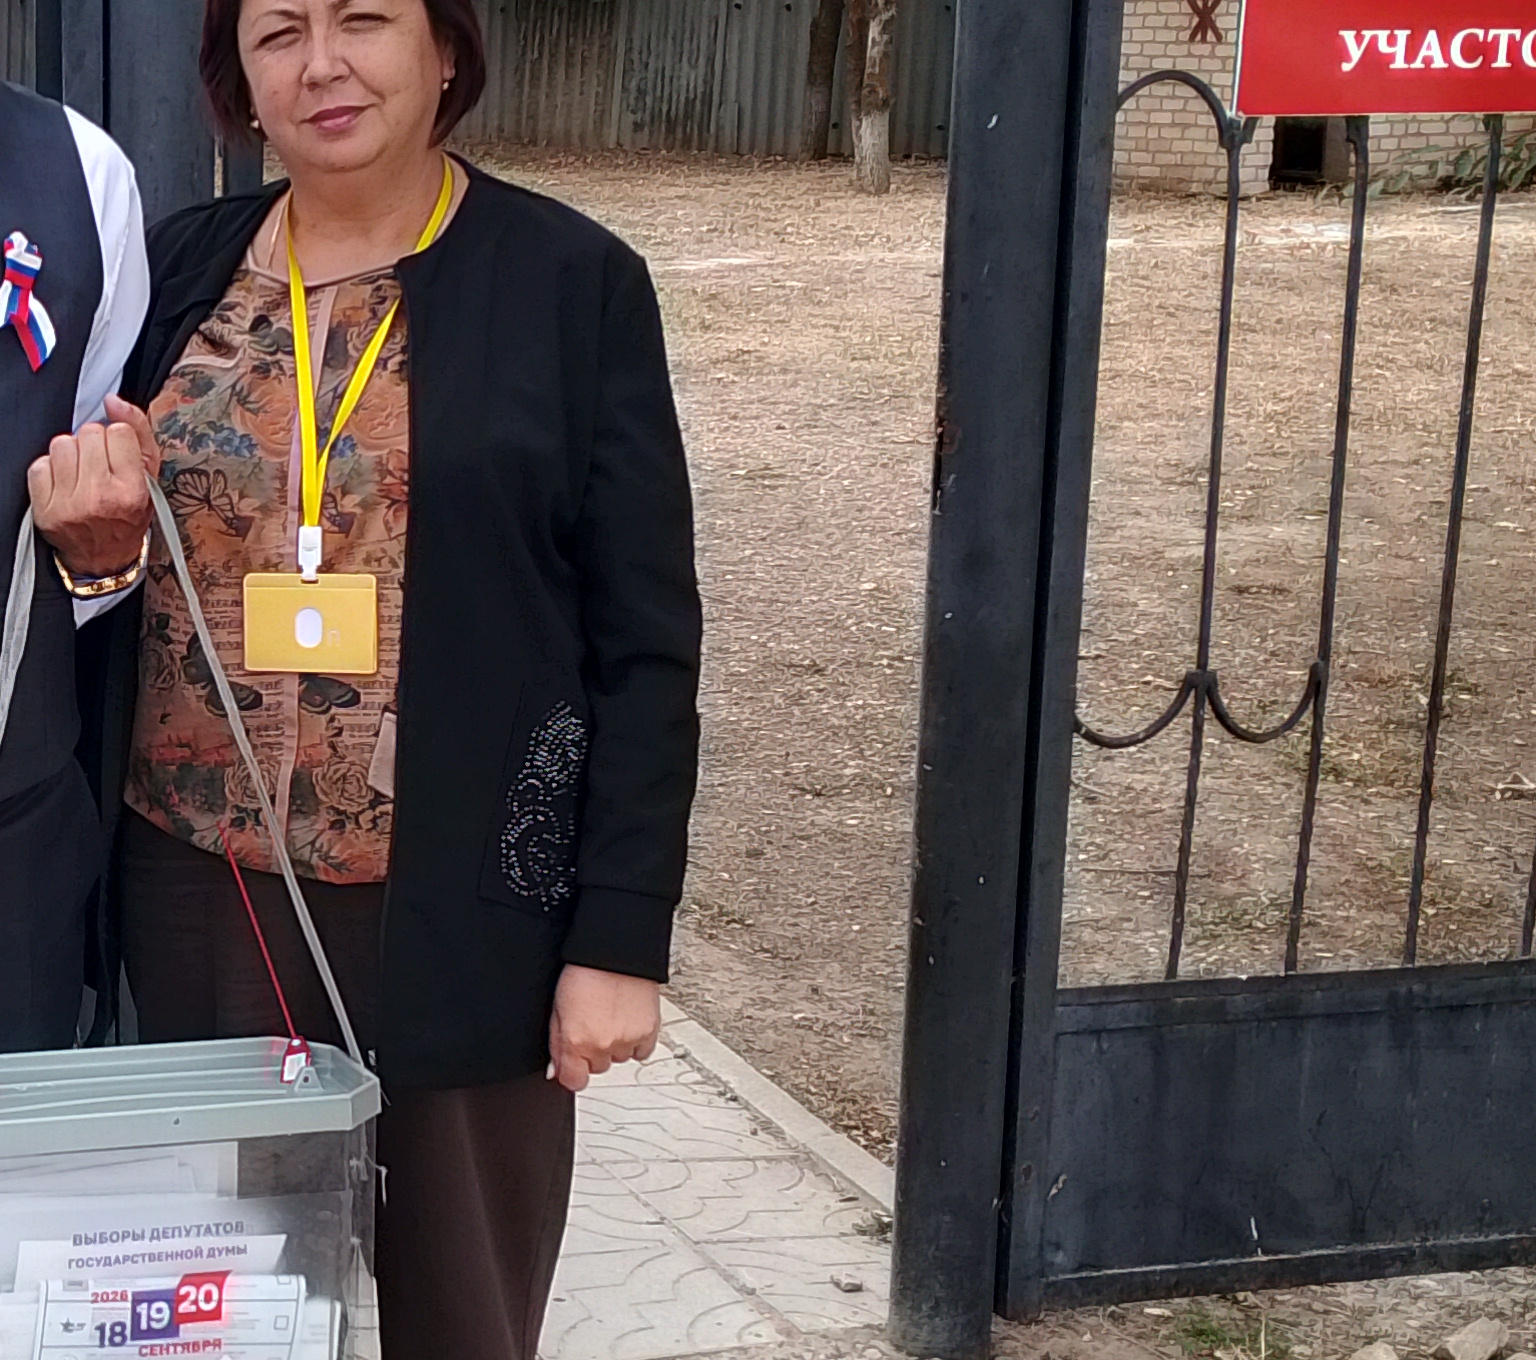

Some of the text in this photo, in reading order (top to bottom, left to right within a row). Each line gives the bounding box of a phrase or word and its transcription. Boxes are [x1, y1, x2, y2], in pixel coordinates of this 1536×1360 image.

[72, 1221, 245, 1247] ВЫБОРЫ ДЕПУТАТОВ
[68, 1244, 248, 1269] ГОСУДАРСТВЕННОЙ ДУМЫ
[90, 1290, 130, 1304] 2026
[94, 1283, 220, 1348] 18 19 20
[138, 1338, 223, 1357] СЕНТЯБРЯ
